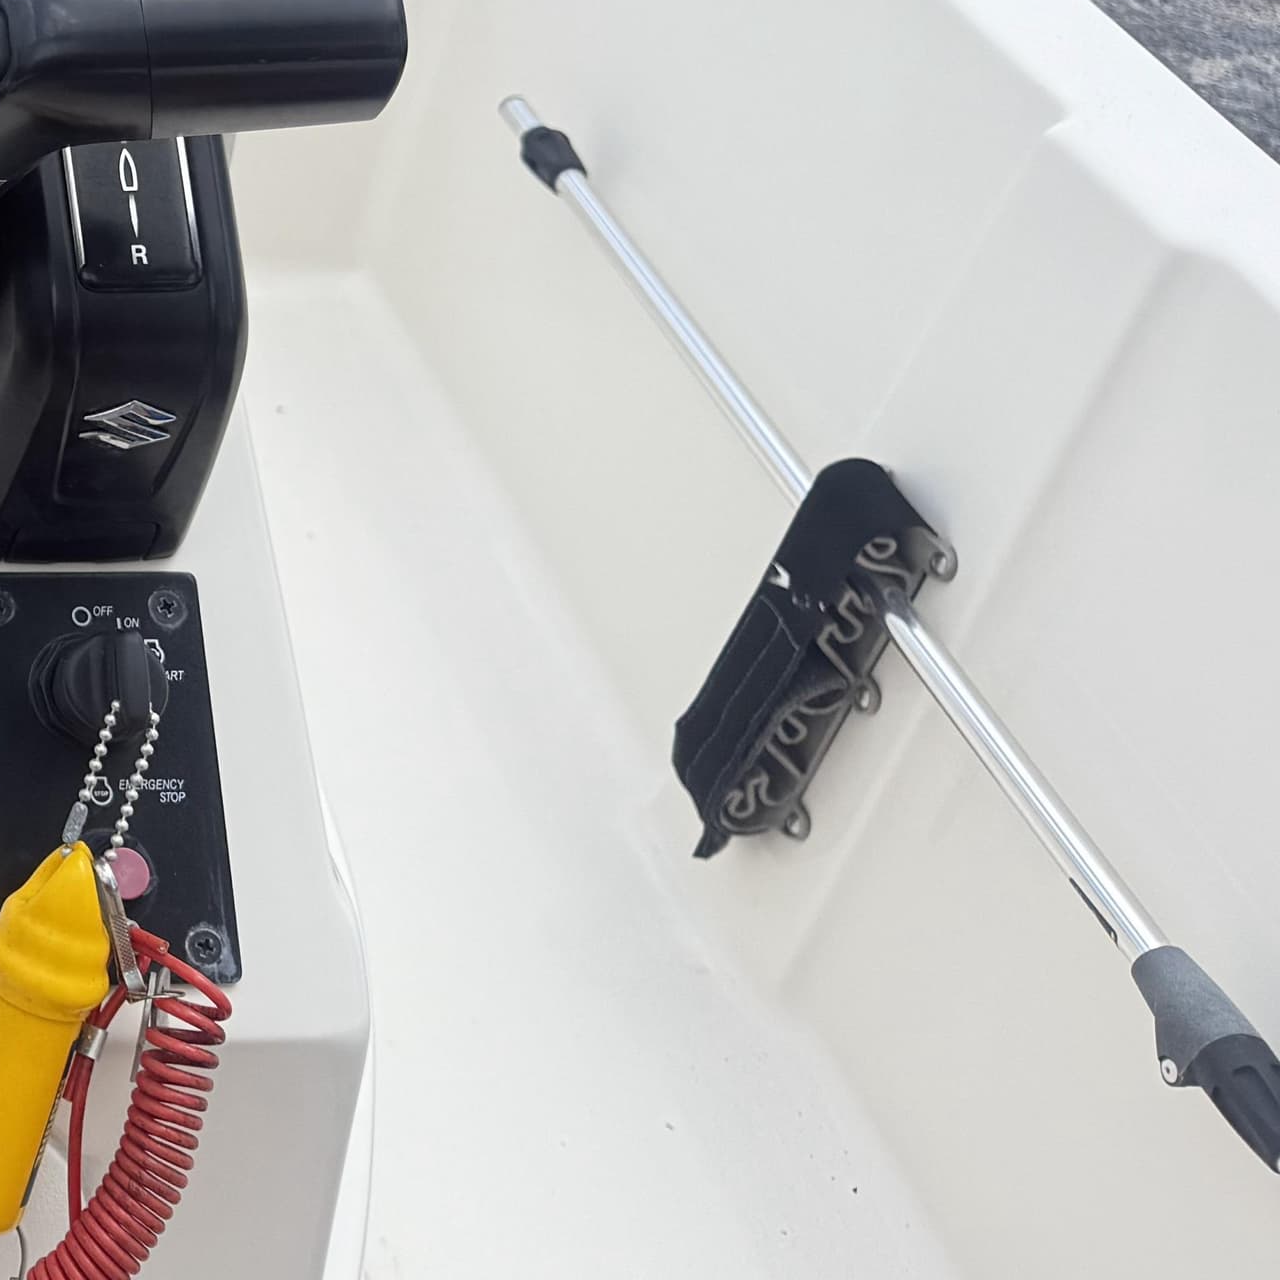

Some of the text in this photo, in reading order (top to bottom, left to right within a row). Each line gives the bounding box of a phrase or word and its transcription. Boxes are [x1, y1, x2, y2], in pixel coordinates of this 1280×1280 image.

[130, 244, 149, 265] R
[92, 605, 113, 617] OFF
[123, 618, 140, 628] ON
[159, 791, 186, 803] STOP
